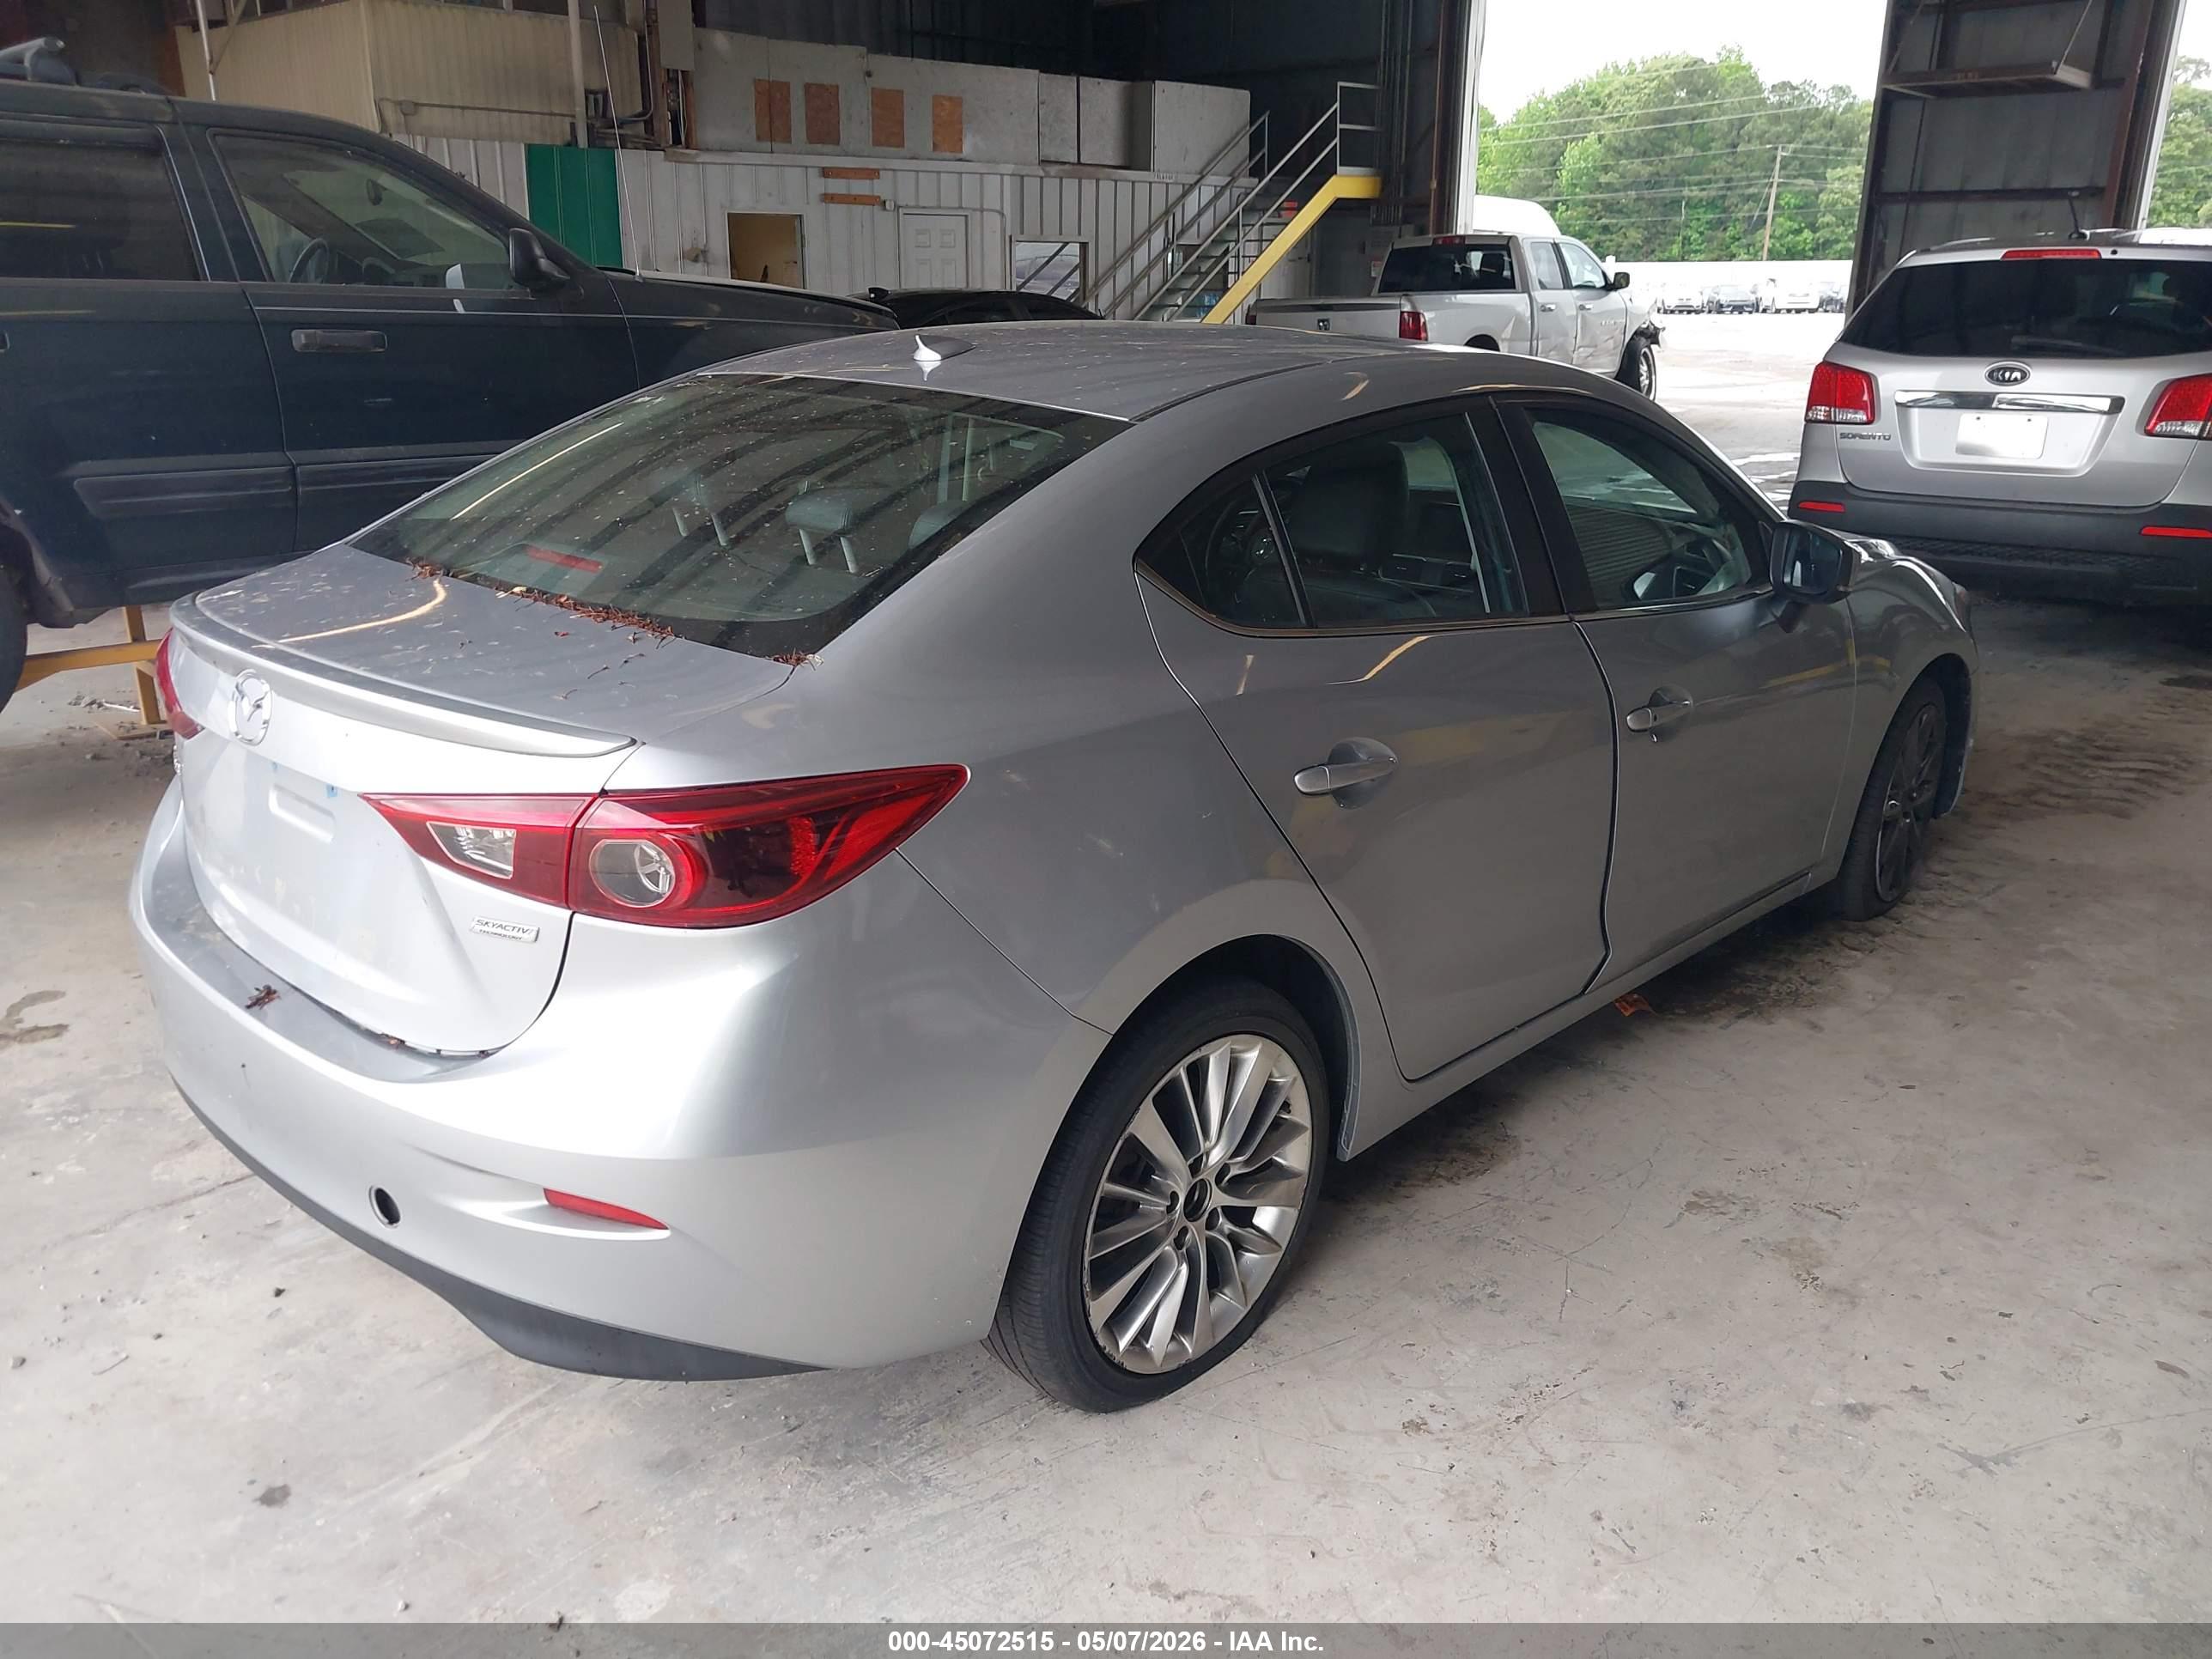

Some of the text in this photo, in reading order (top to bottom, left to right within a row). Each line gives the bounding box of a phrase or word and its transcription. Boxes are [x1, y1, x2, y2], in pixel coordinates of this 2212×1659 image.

[1993, 369, 2021, 381] KIA
[1839, 432, 1892, 441] SORENTO
[476, 919, 530, 934] SKYACTIV
